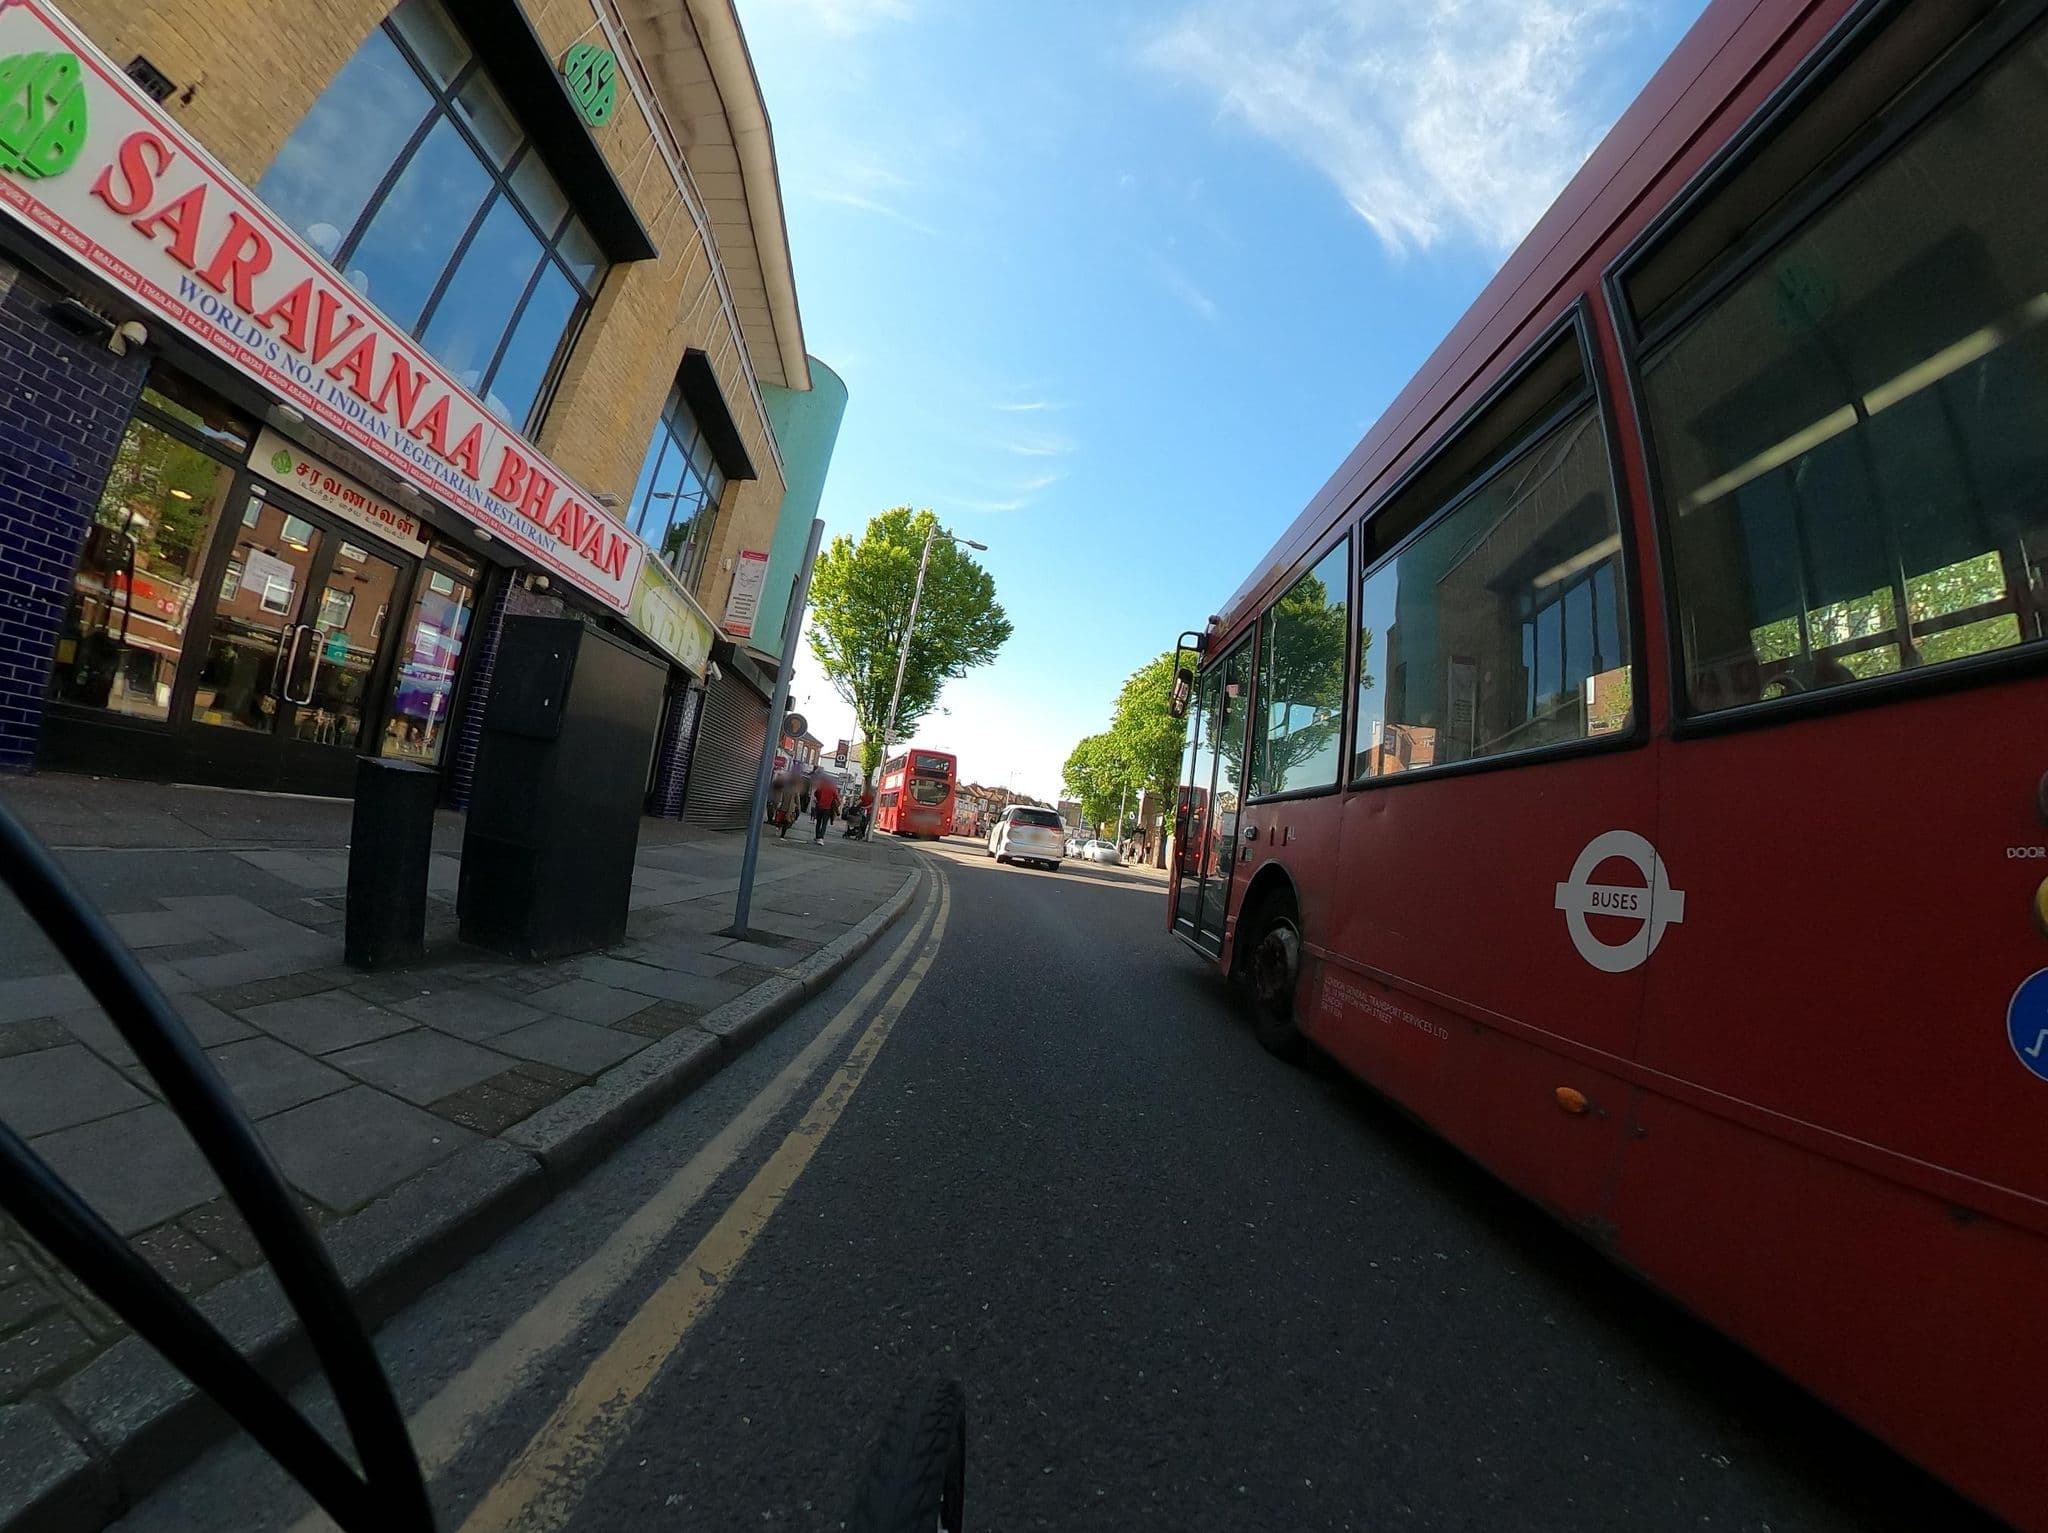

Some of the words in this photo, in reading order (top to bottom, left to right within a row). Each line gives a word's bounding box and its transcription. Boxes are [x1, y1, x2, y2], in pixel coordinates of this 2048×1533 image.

[92, 249, 139, 286] MALAYSIA
[142, 285, 183, 314] THAILAND
[90, 131, 483, 481] SARAVANAA
[489, 446, 632, 581] BHAVAN
[179, 275, 280, 361] WORLD'S
[281, 352, 325, 394] NO.1
[327, 386, 391, 440] INDIAN
[394, 432, 483, 504] VEGETARIAN
[485, 496, 558, 553] RESTAURANT
[296, 462, 415, 536] சரவணபவன்
[2006, 846, 2048, 858] DOOR
[1592, 891, 1638, 911] BUSES
[1402, 1011, 1433, 1034] SERVICES
[1433, 1026, 1449, 1040] LTD
